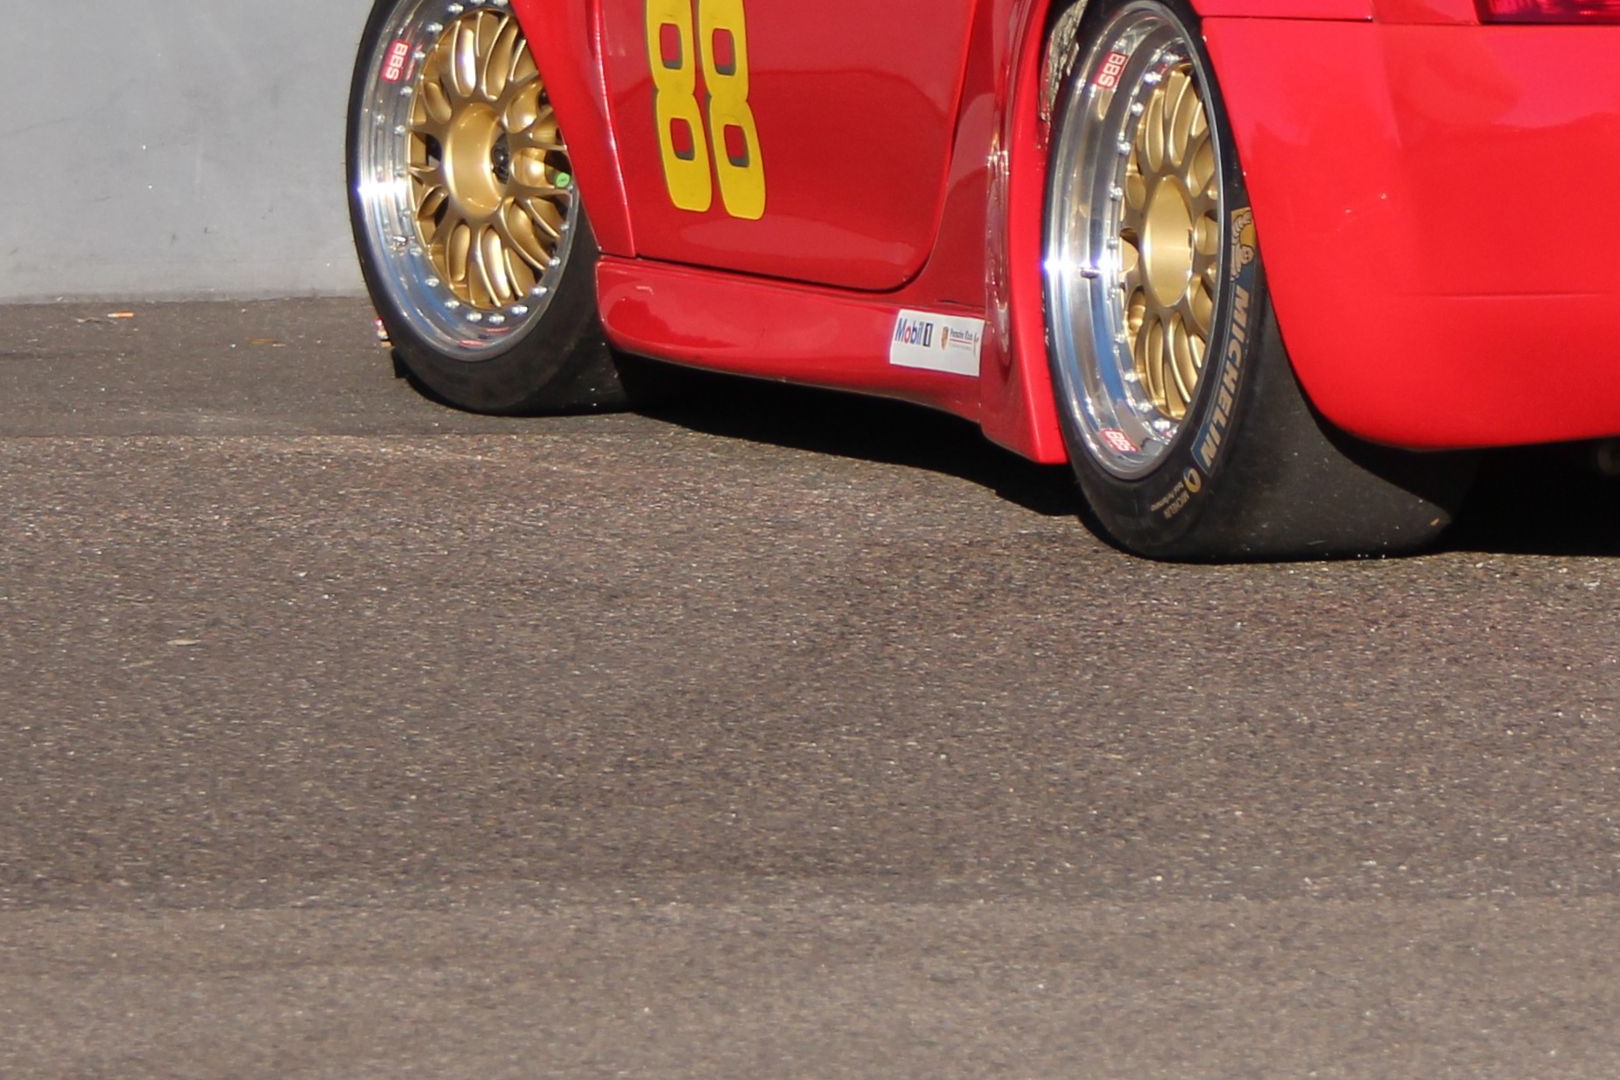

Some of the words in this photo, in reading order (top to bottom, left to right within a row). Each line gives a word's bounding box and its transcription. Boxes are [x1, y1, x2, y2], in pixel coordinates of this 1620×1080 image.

[385, 42, 408, 81] BBS
[1097, 53, 1126, 87] BBS
[895, 318, 924, 345] Mobil
[1201, 284, 1249, 467] MICHELIN
